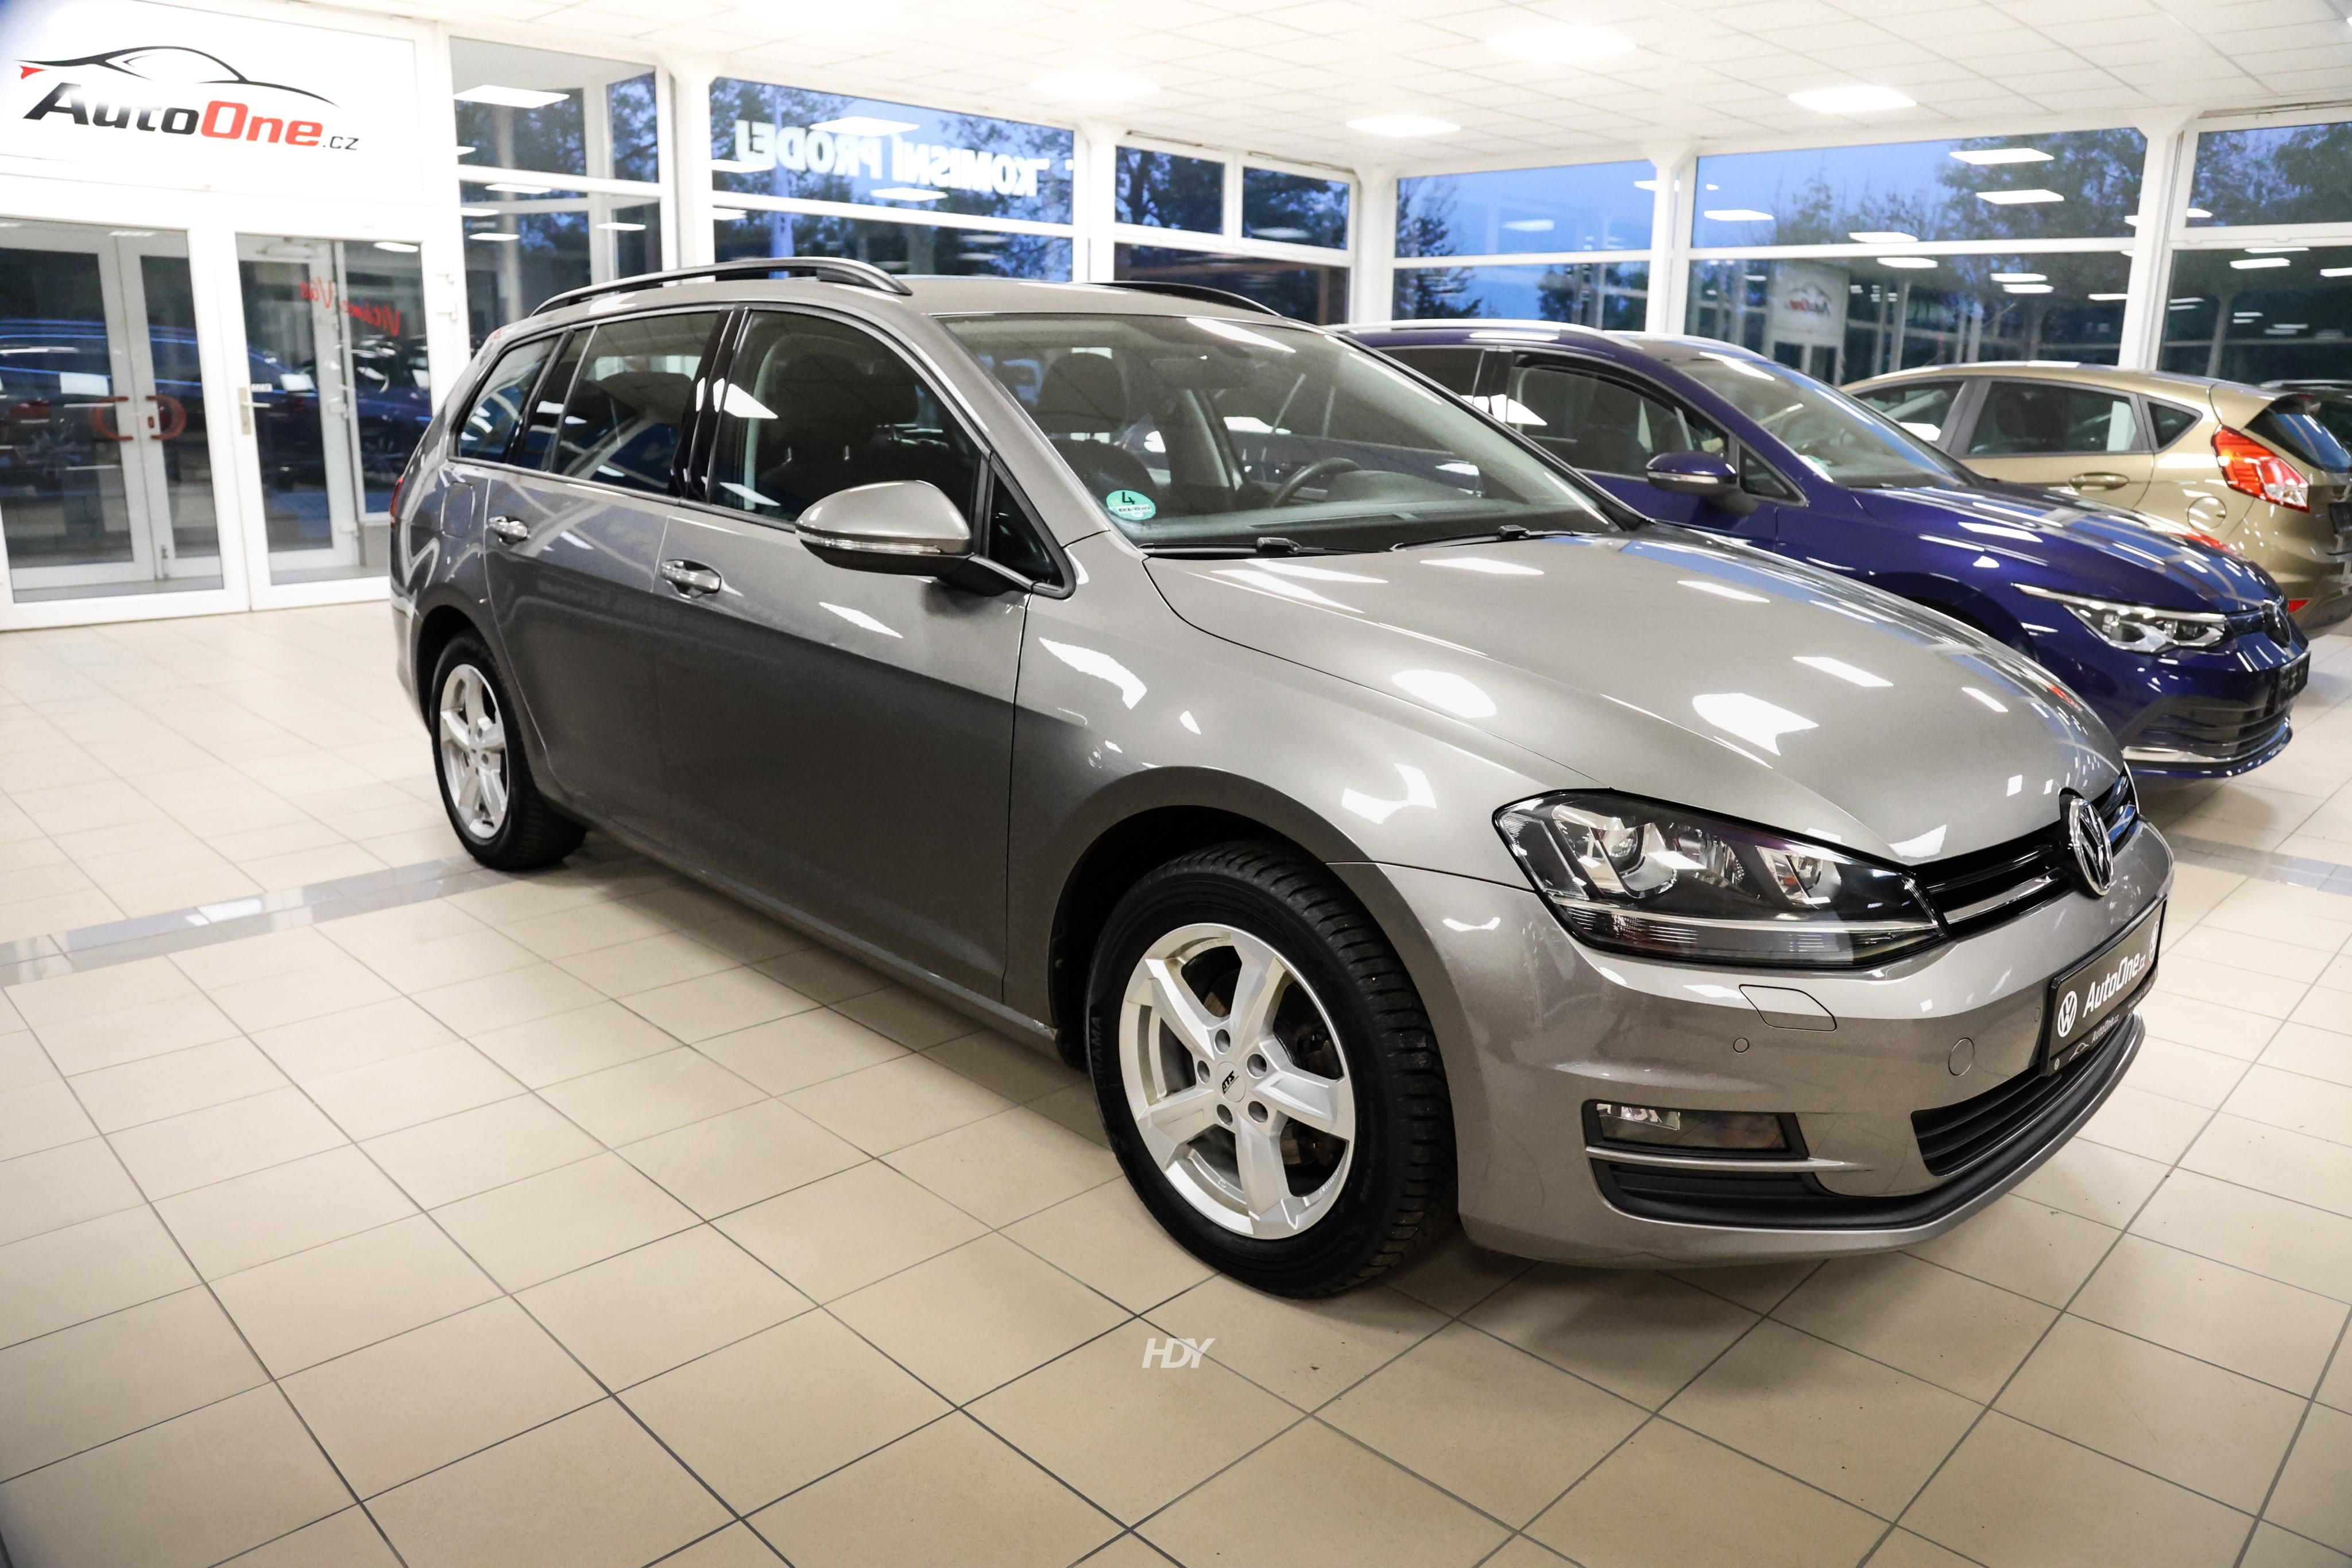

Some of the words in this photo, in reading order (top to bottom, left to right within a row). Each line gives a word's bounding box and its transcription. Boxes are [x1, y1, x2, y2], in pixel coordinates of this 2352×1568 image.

[22, 82, 359, 151] AutoOne.cz
[1121, 491, 1135, 505] 4
[2082, 953, 2146, 1019] AutoOne.cz
[2091, 1014, 2120, 1043] AutoOne.cz
